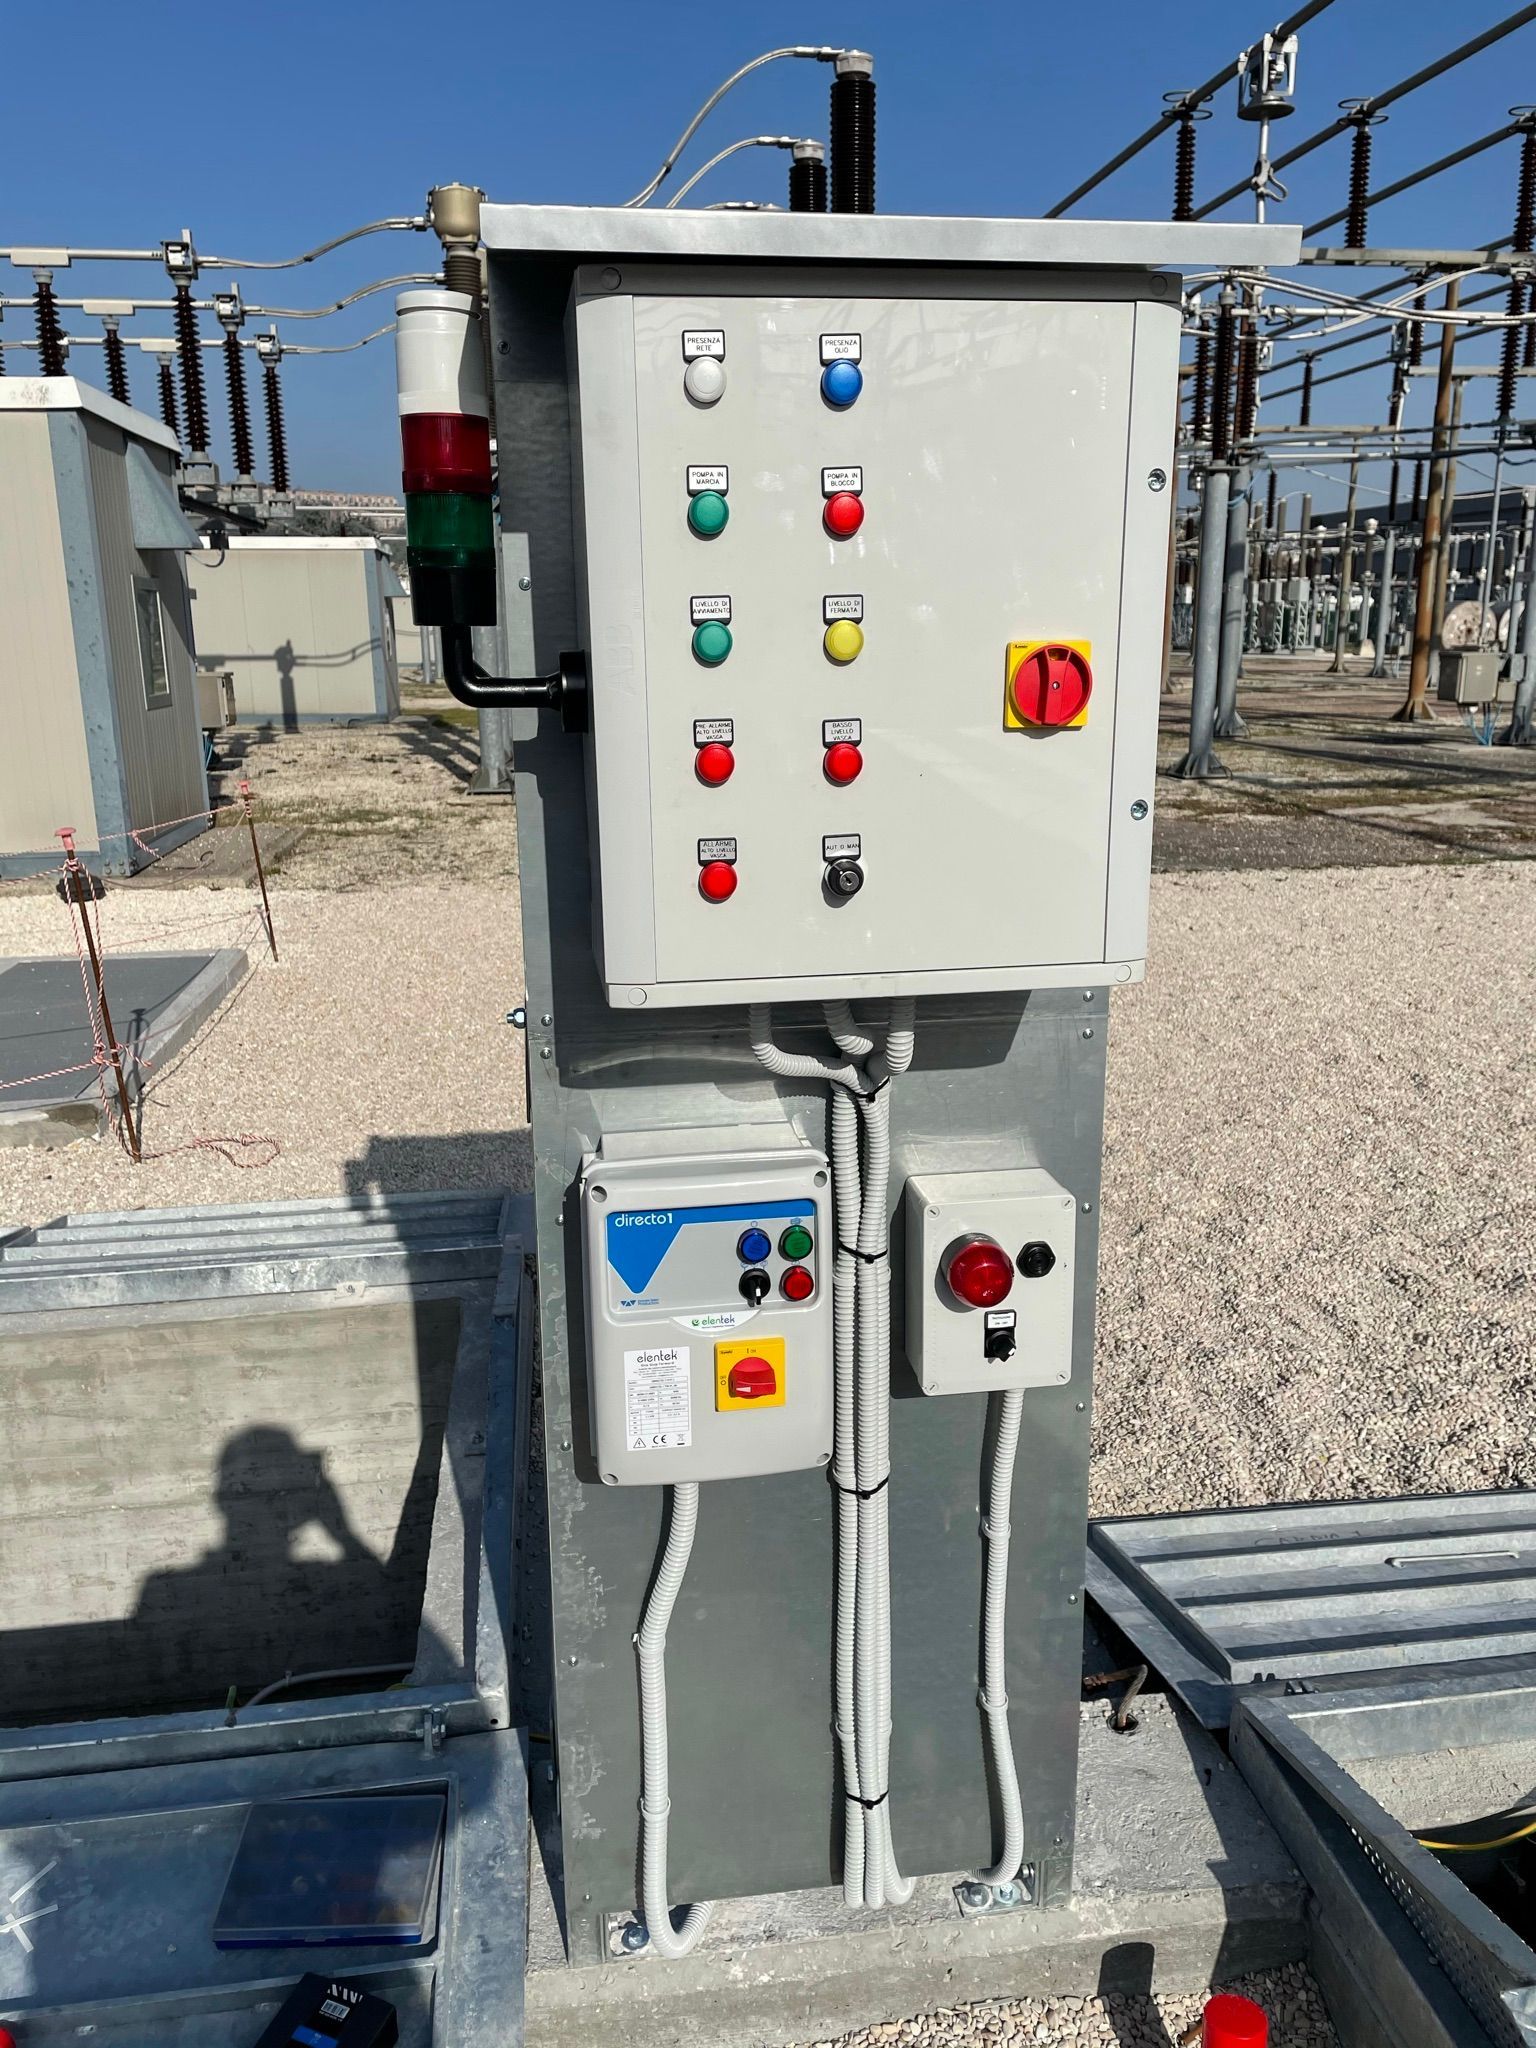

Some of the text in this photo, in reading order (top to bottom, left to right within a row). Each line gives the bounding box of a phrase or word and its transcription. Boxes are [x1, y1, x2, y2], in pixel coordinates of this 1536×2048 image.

[614, 1212, 673, 1228] directo1
[702, 1314, 735, 1326] elentek
[636, 1349, 678, 1363] elentek
